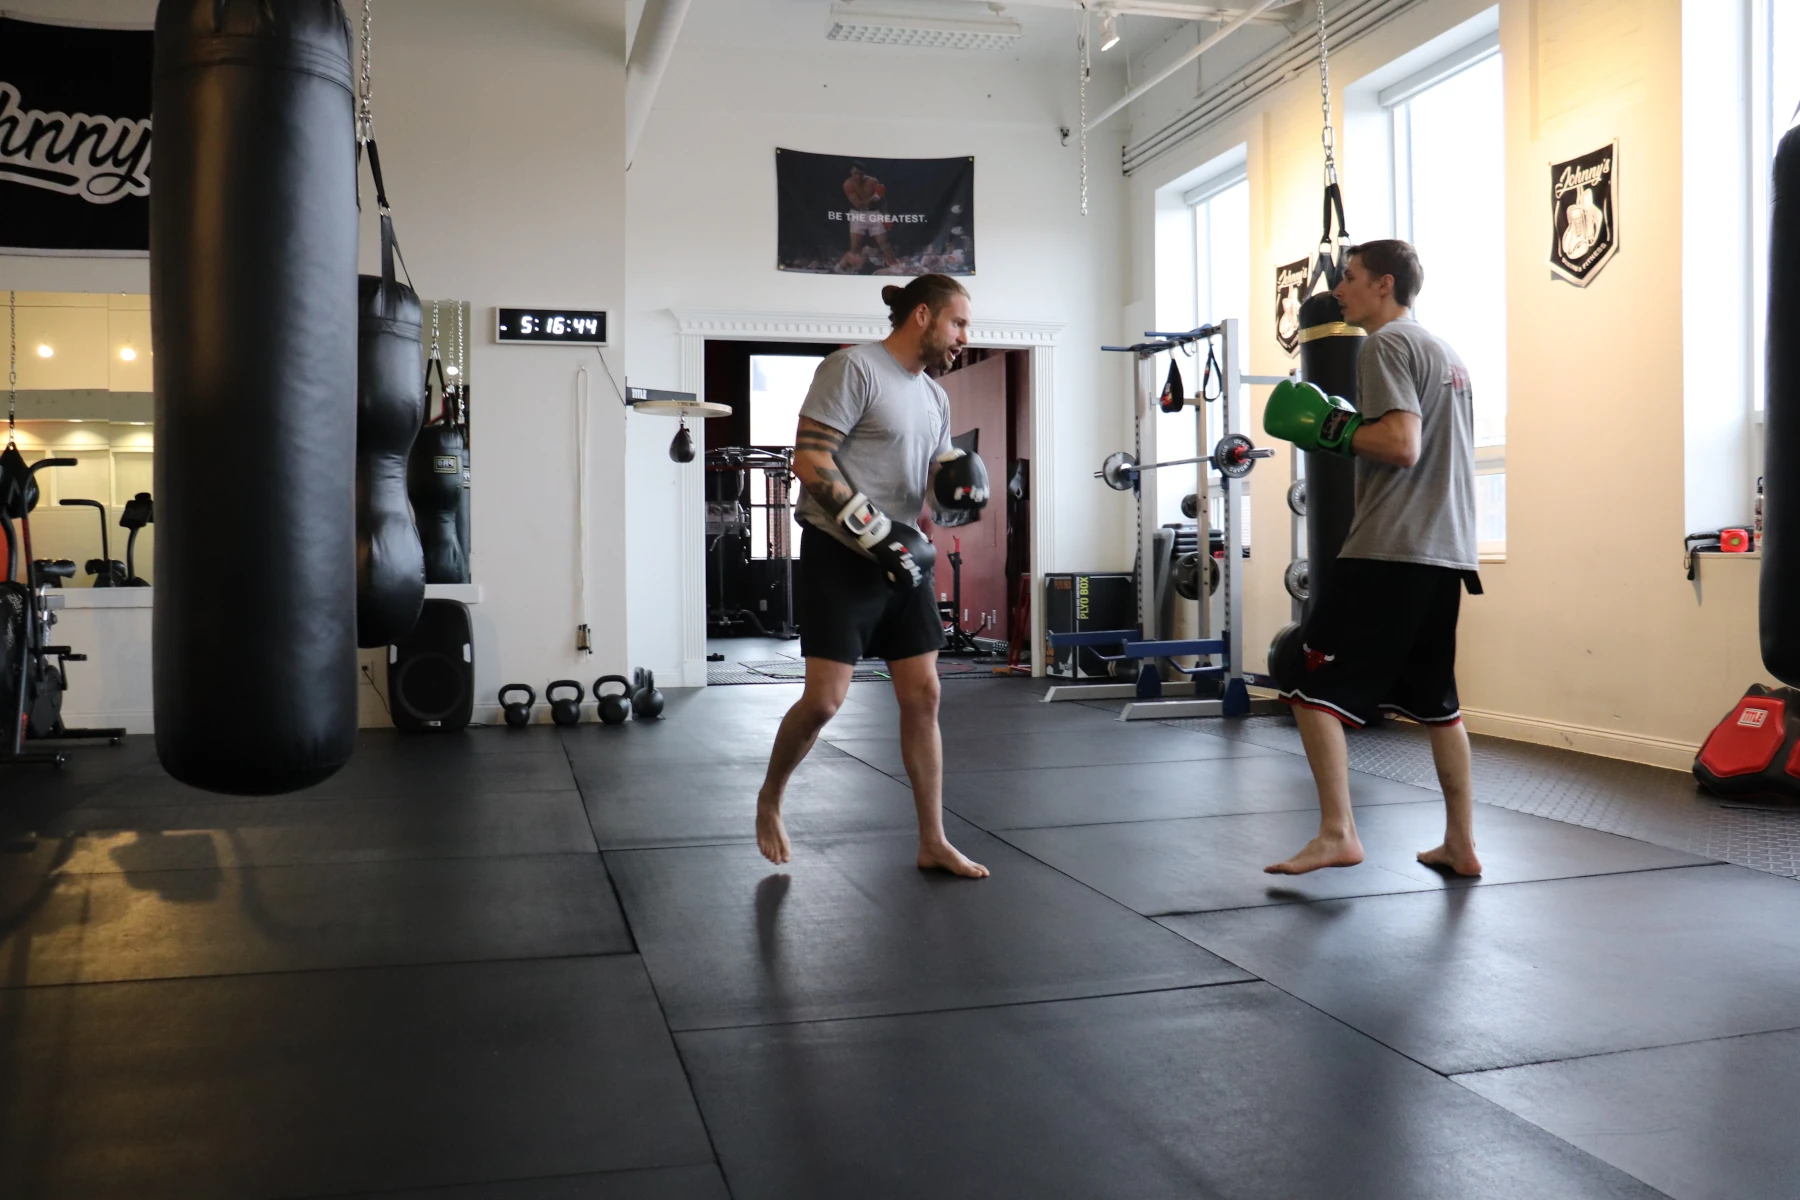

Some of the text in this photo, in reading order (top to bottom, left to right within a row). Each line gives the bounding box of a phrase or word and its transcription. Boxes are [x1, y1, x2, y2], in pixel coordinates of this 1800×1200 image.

[1555, 158, 1611, 199] Johnny's
[828, 211, 928, 223] BE THE GREATEST.
[631, 388, 648, 400] TITLE
[1080, 576, 1089, 620] PLYO BOX
[1742, 710, 1765, 724] TITLE
